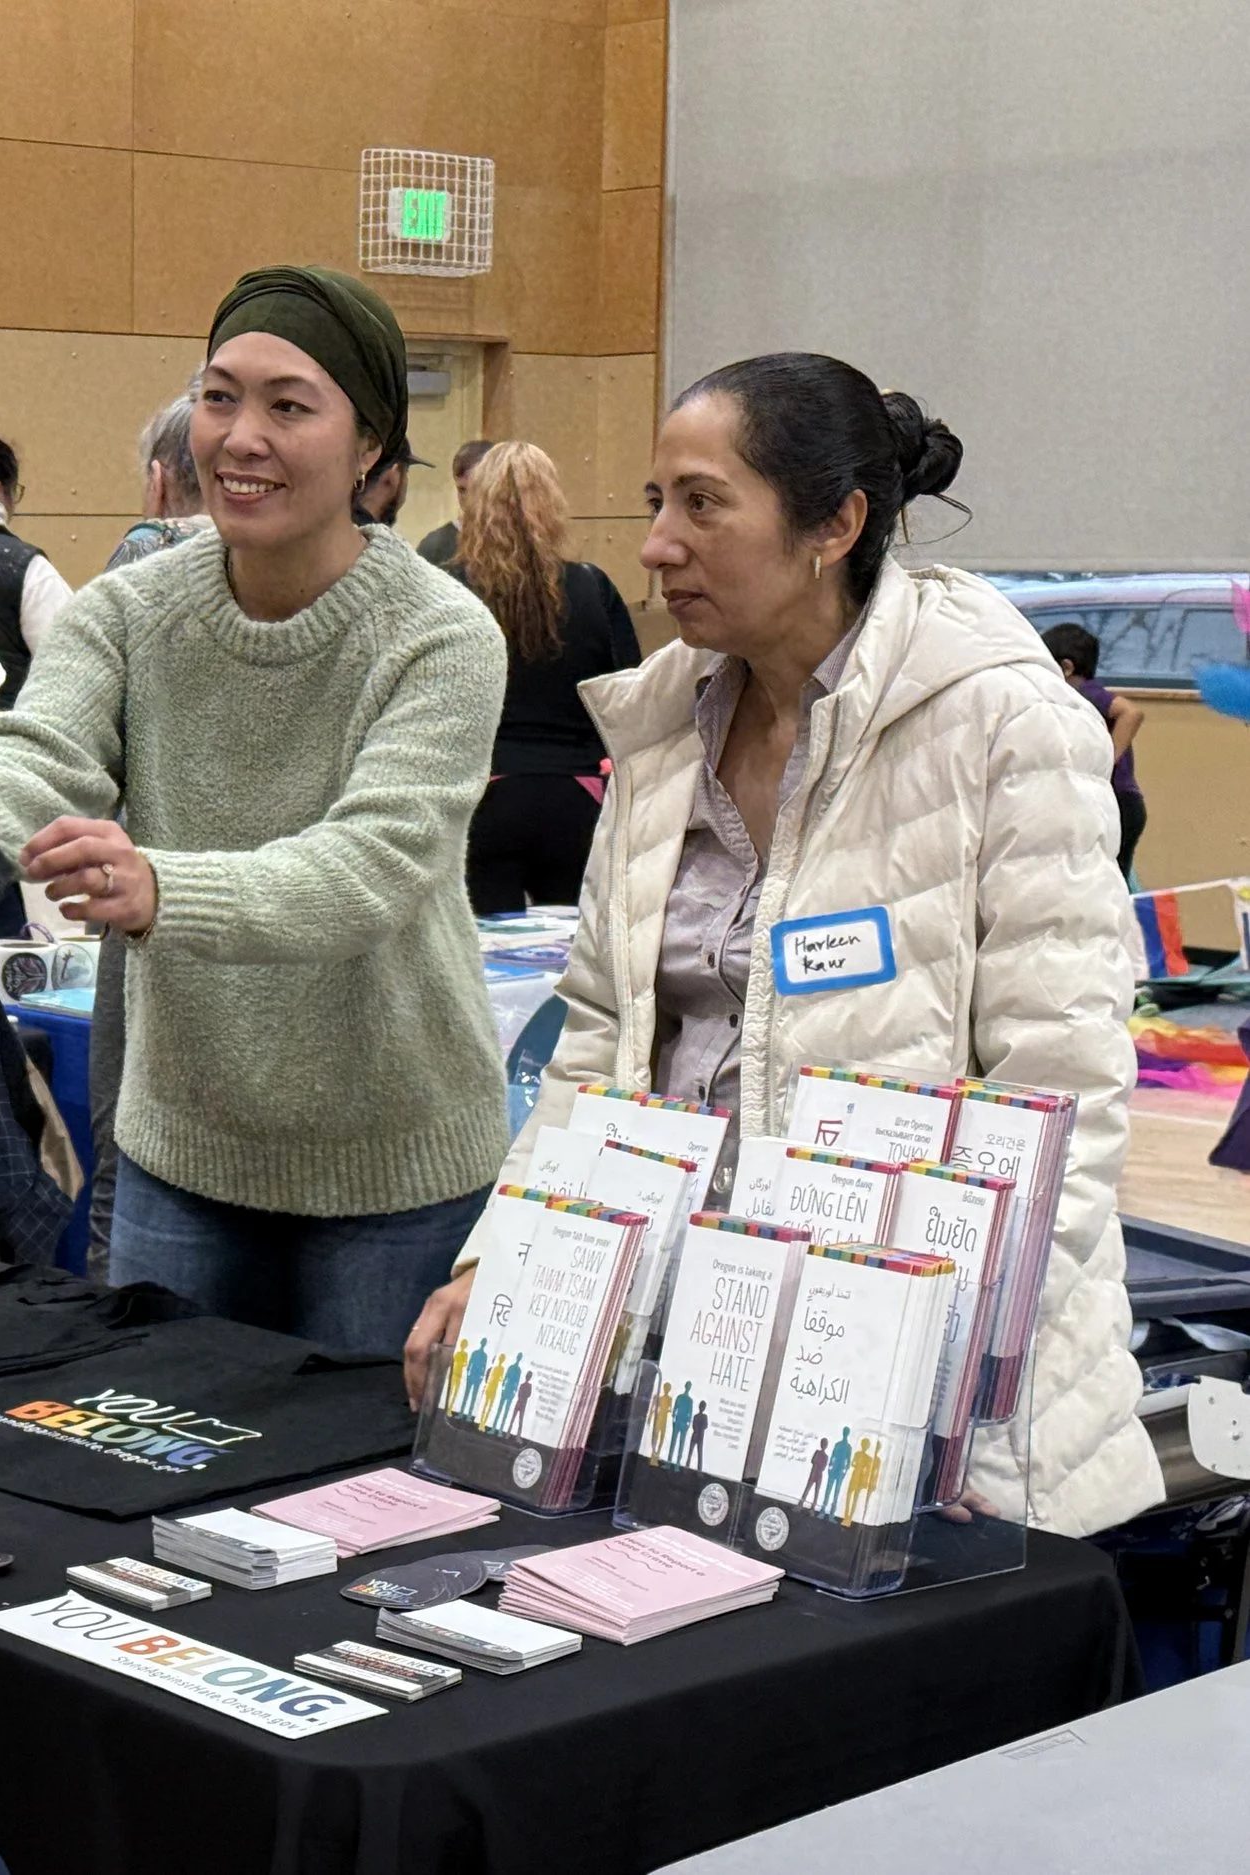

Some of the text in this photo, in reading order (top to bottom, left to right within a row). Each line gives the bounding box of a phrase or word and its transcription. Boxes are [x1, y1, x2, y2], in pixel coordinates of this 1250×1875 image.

[795, 934, 861, 955] Harleen
[985, 1133, 1026, 1151] 오리건은
[831, 1173, 854, 1187] Oregon
[836, 1191, 868, 1223] LÊN
[532, 1264, 597, 1300] TAWM TSAM
[713, 1259, 735, 1274] Oregon
[737, 1264, 744, 1274] is
[745, 1265, 767, 1280] taking
[528, 1293, 551, 1318] KEV
[552, 1299, 589, 1329] NTXUB
[712, 1277, 769, 1319] STAND
[535, 1323, 581, 1356] NTXAUG
[690, 1310, 764, 1354] AGAINST
[709, 1351, 755, 1392] HATE
[795, 1345, 823, 1365] ضد
[790, 1367, 850, 1405] الكراهية
[73, 1388, 196, 1424] YOU
[31, 1599, 139, 1641] YOU
[111, 1655, 299, 1732] StandAgainstHate.Oregon.gov
